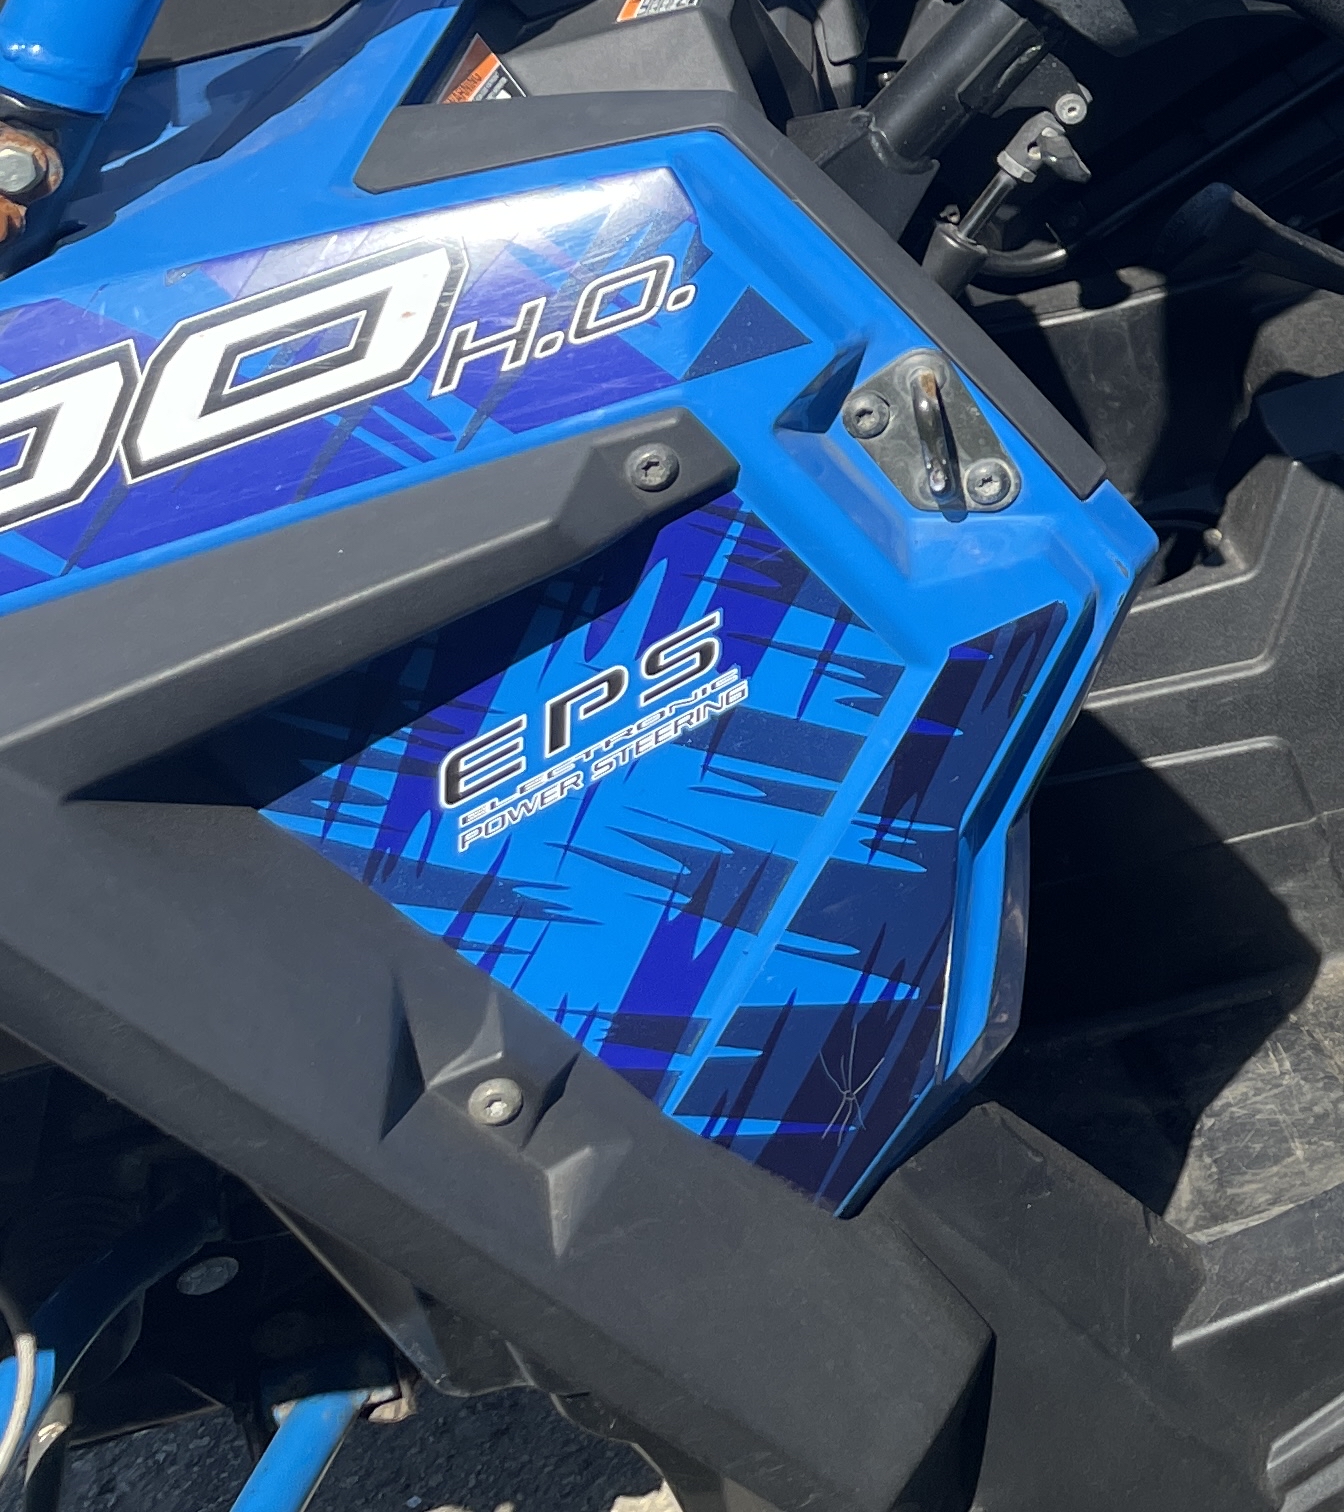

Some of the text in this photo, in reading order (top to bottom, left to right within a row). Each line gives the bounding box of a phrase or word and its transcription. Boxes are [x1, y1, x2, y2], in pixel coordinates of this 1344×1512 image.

[429, 255, 697, 400] H.O.
[440, 607, 724, 809] EPS
[458, 664, 740, 829] ELECTRONIC
[458, 679, 749, 854] POWER STEERING
